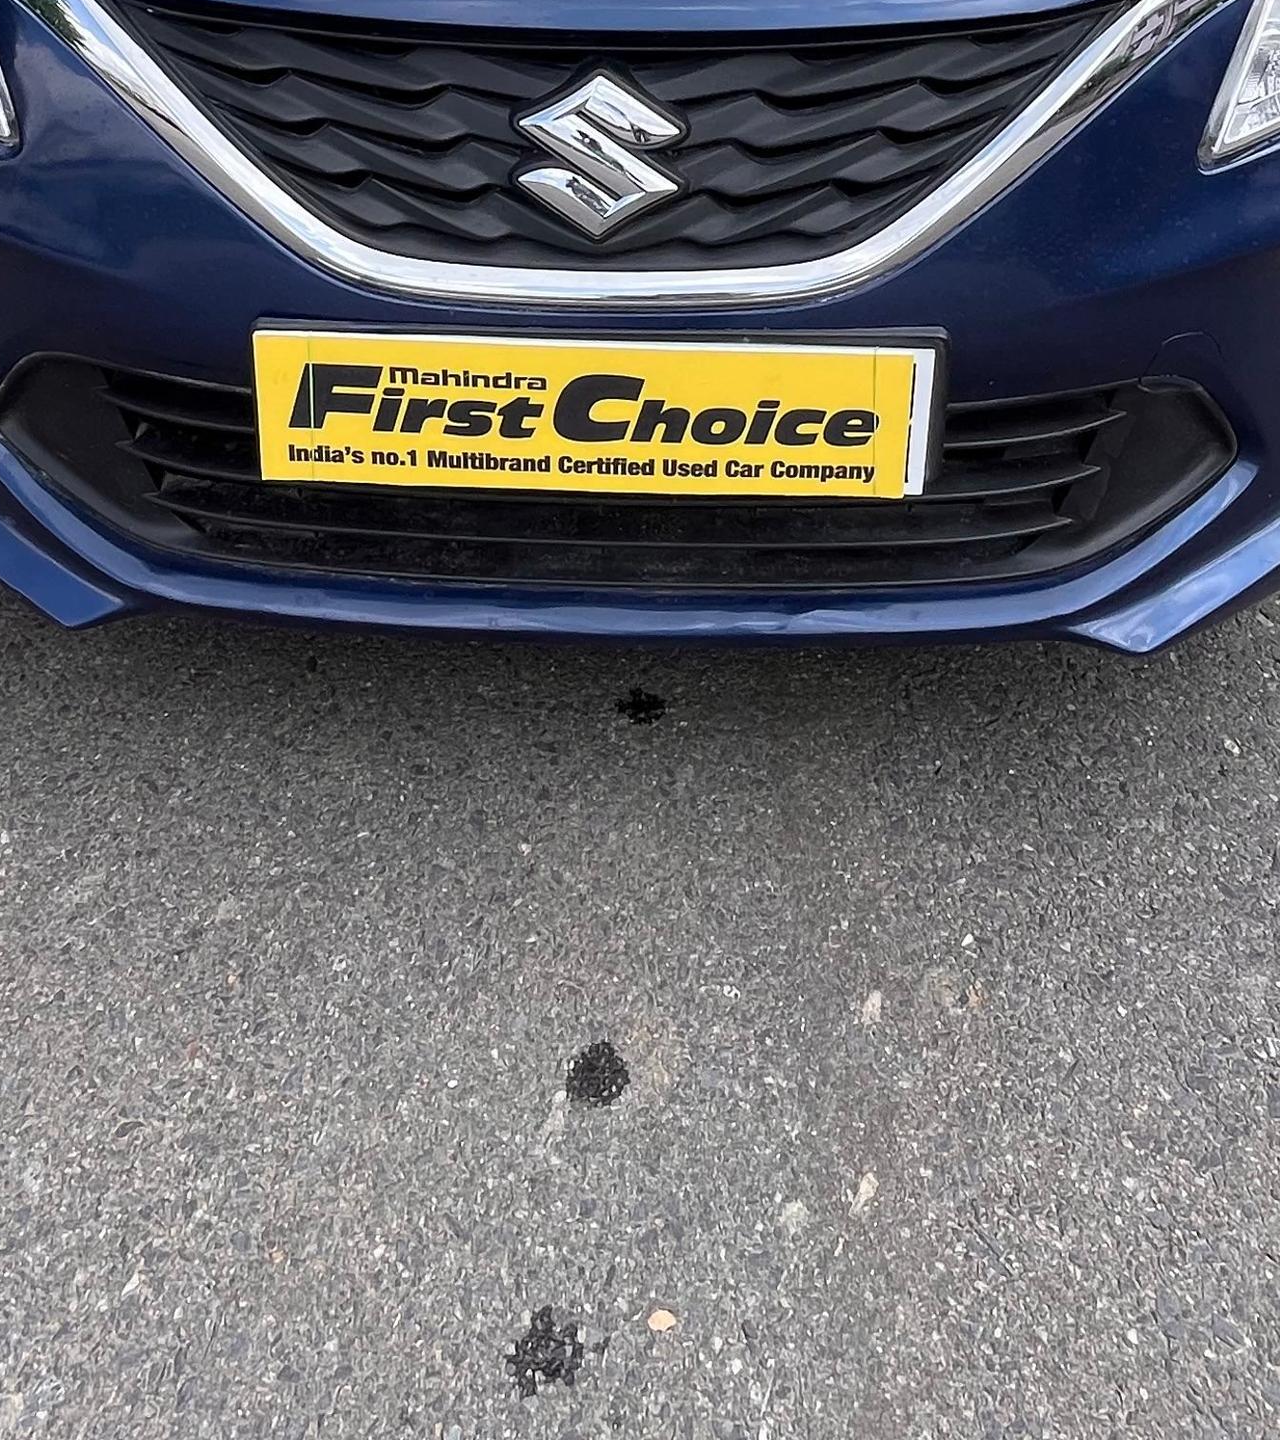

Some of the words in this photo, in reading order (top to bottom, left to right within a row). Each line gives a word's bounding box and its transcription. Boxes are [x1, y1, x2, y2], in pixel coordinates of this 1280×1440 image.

[389, 366, 548, 390] Mahindra
[288, 362, 545, 439] First
[553, 374, 880, 447] Choice
[288, 444, 365, 464] India's
[371, 450, 418, 467] no.1
[428, 450, 551, 473] Multibrand
[558, 456, 655, 477] Certified
[662, 458, 718, 478] Used
[725, 460, 765, 479] Car
[770, 460, 875, 483] Company
